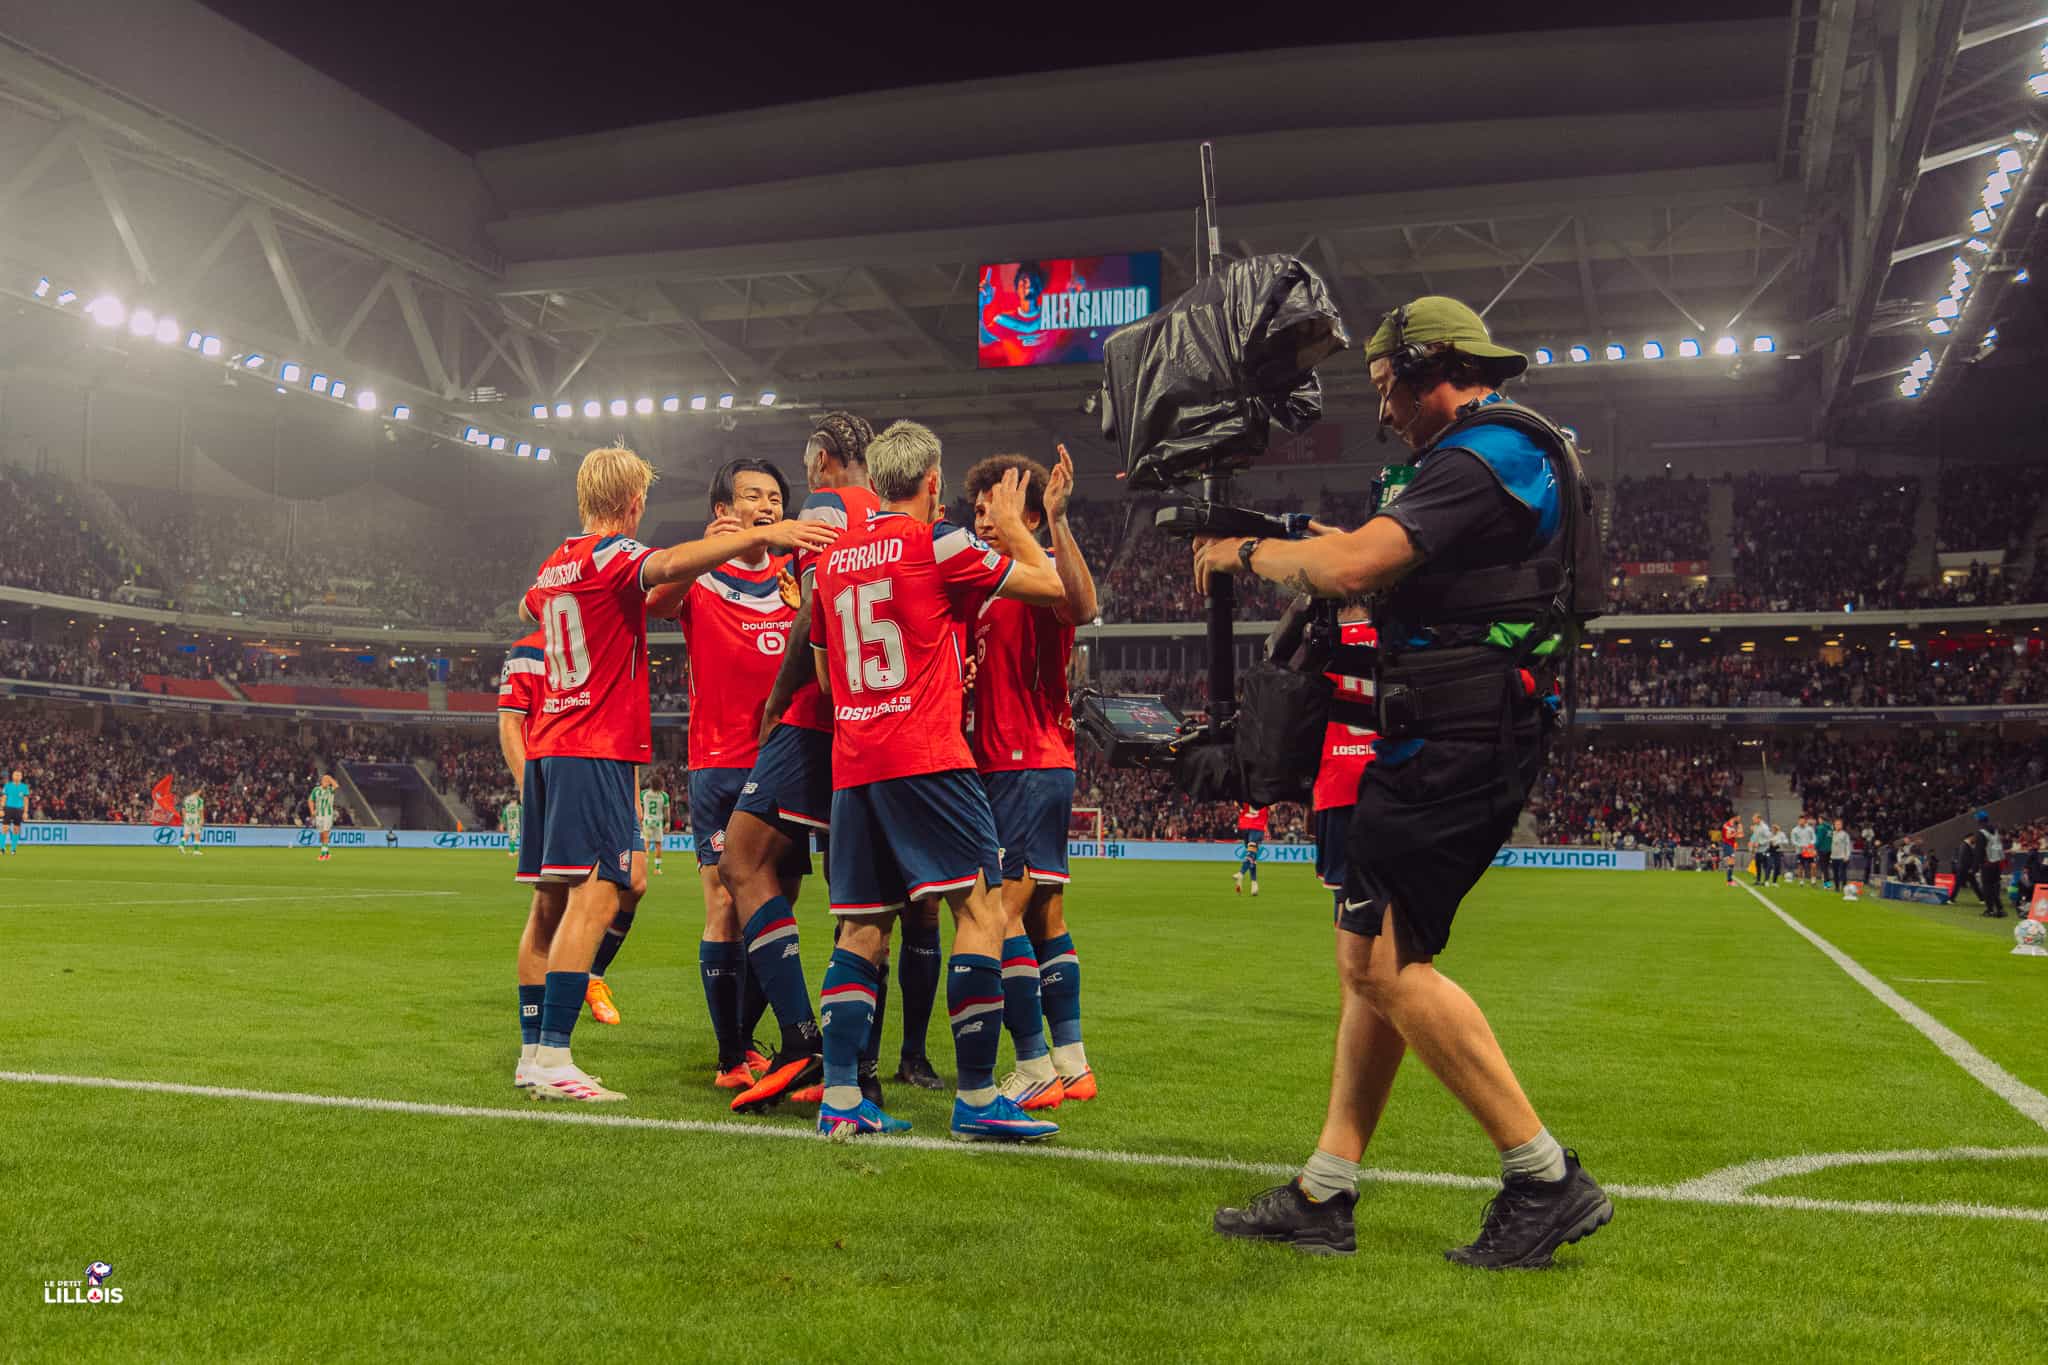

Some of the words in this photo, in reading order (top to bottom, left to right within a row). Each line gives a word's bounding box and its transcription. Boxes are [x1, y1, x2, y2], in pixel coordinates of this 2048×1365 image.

[1040, 287, 1148, 330] ALEXSANDRO
[826, 538, 903, 575] PERRAUD
[742, 620, 793, 631] boulanger
[542, 592, 591, 692] 10
[833, 577, 907, 694] 15
[1332, 744, 1367, 756] LOSC
[648, 801, 657, 815] 2
[18, 827, 68, 841] UNDAI
[180, 829, 237, 843] UNDAI
[319, 832, 366, 844] YUNDAI
[468, 834, 520, 847] HYUN
[1069, 843, 1125, 857] UNDAI
[1523, 851, 1617, 867] HYUNDAI
